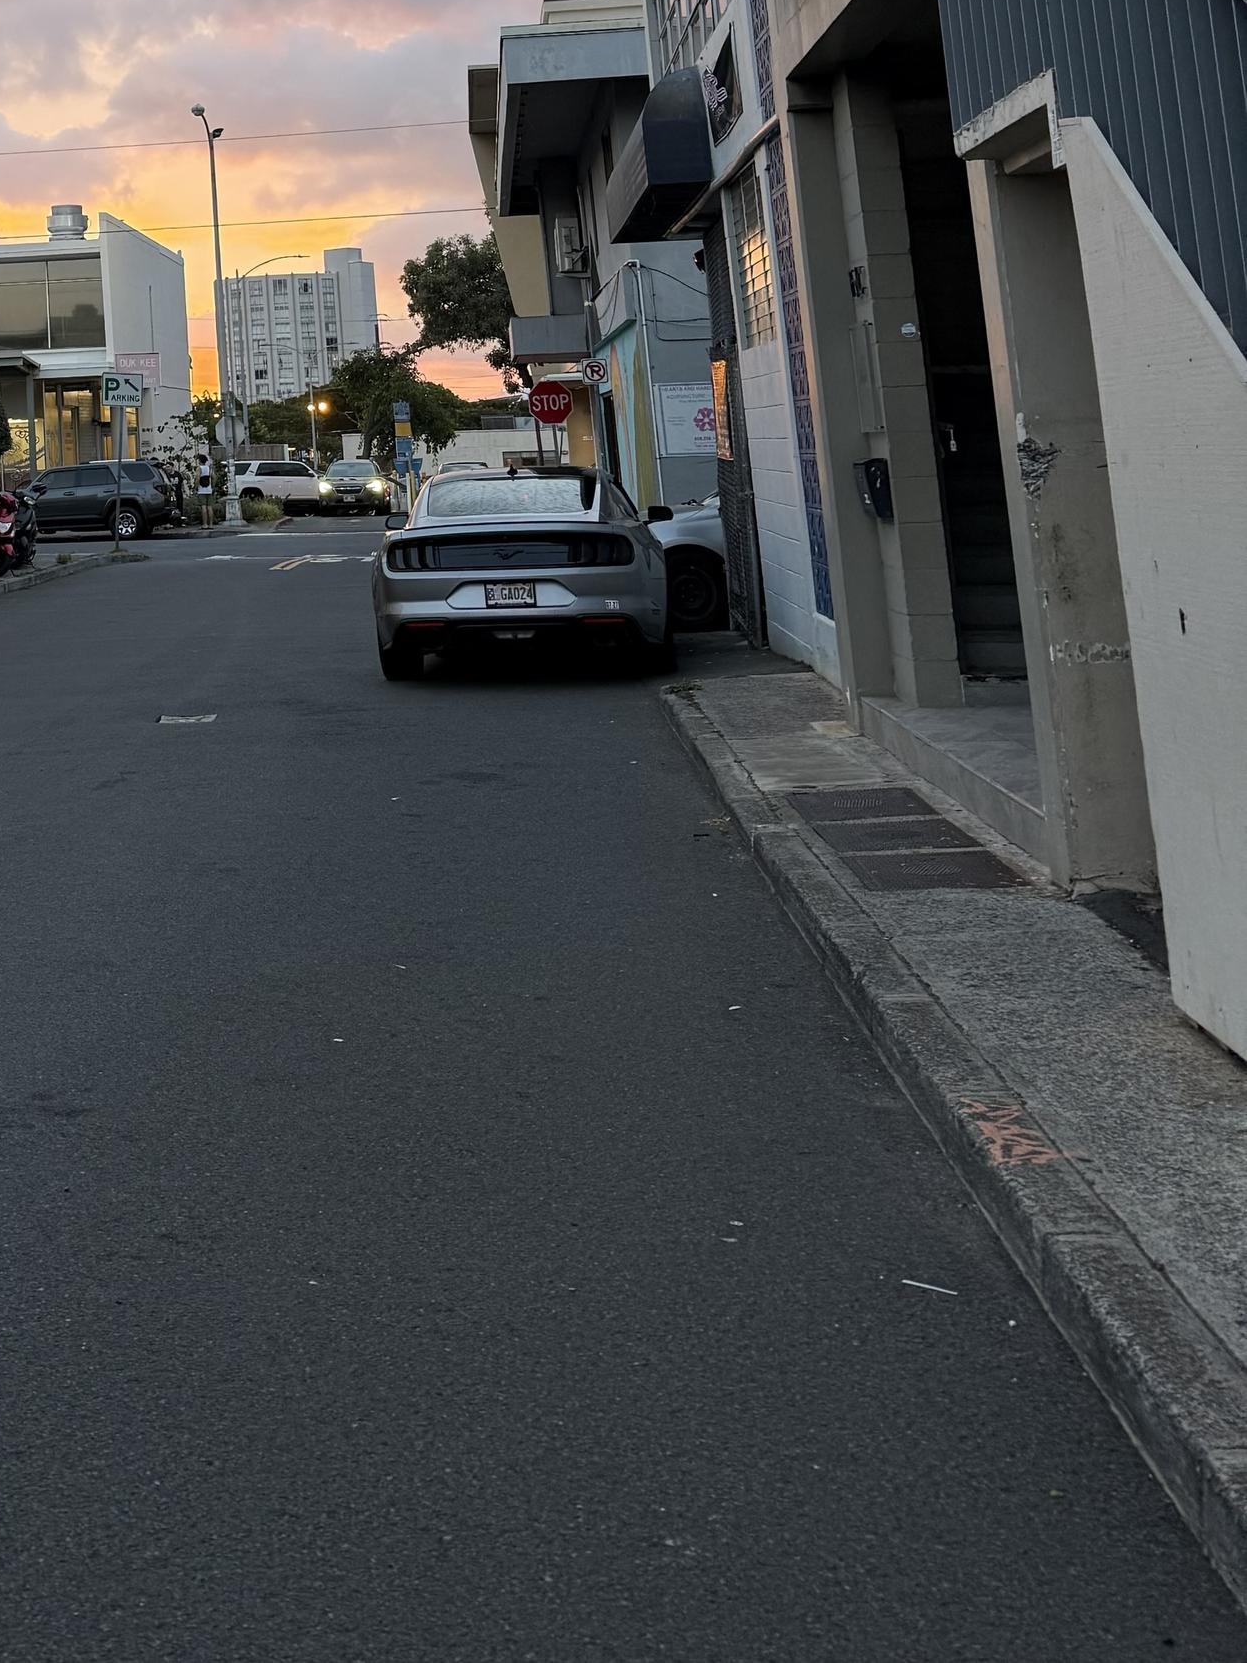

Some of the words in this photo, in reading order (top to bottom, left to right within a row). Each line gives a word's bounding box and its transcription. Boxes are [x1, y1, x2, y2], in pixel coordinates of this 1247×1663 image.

[120, 359, 136, 368] DUK
[140, 358, 157, 368] KEE
[105, 378, 140, 402] PARKING
[533, 394, 569, 411] STOP
